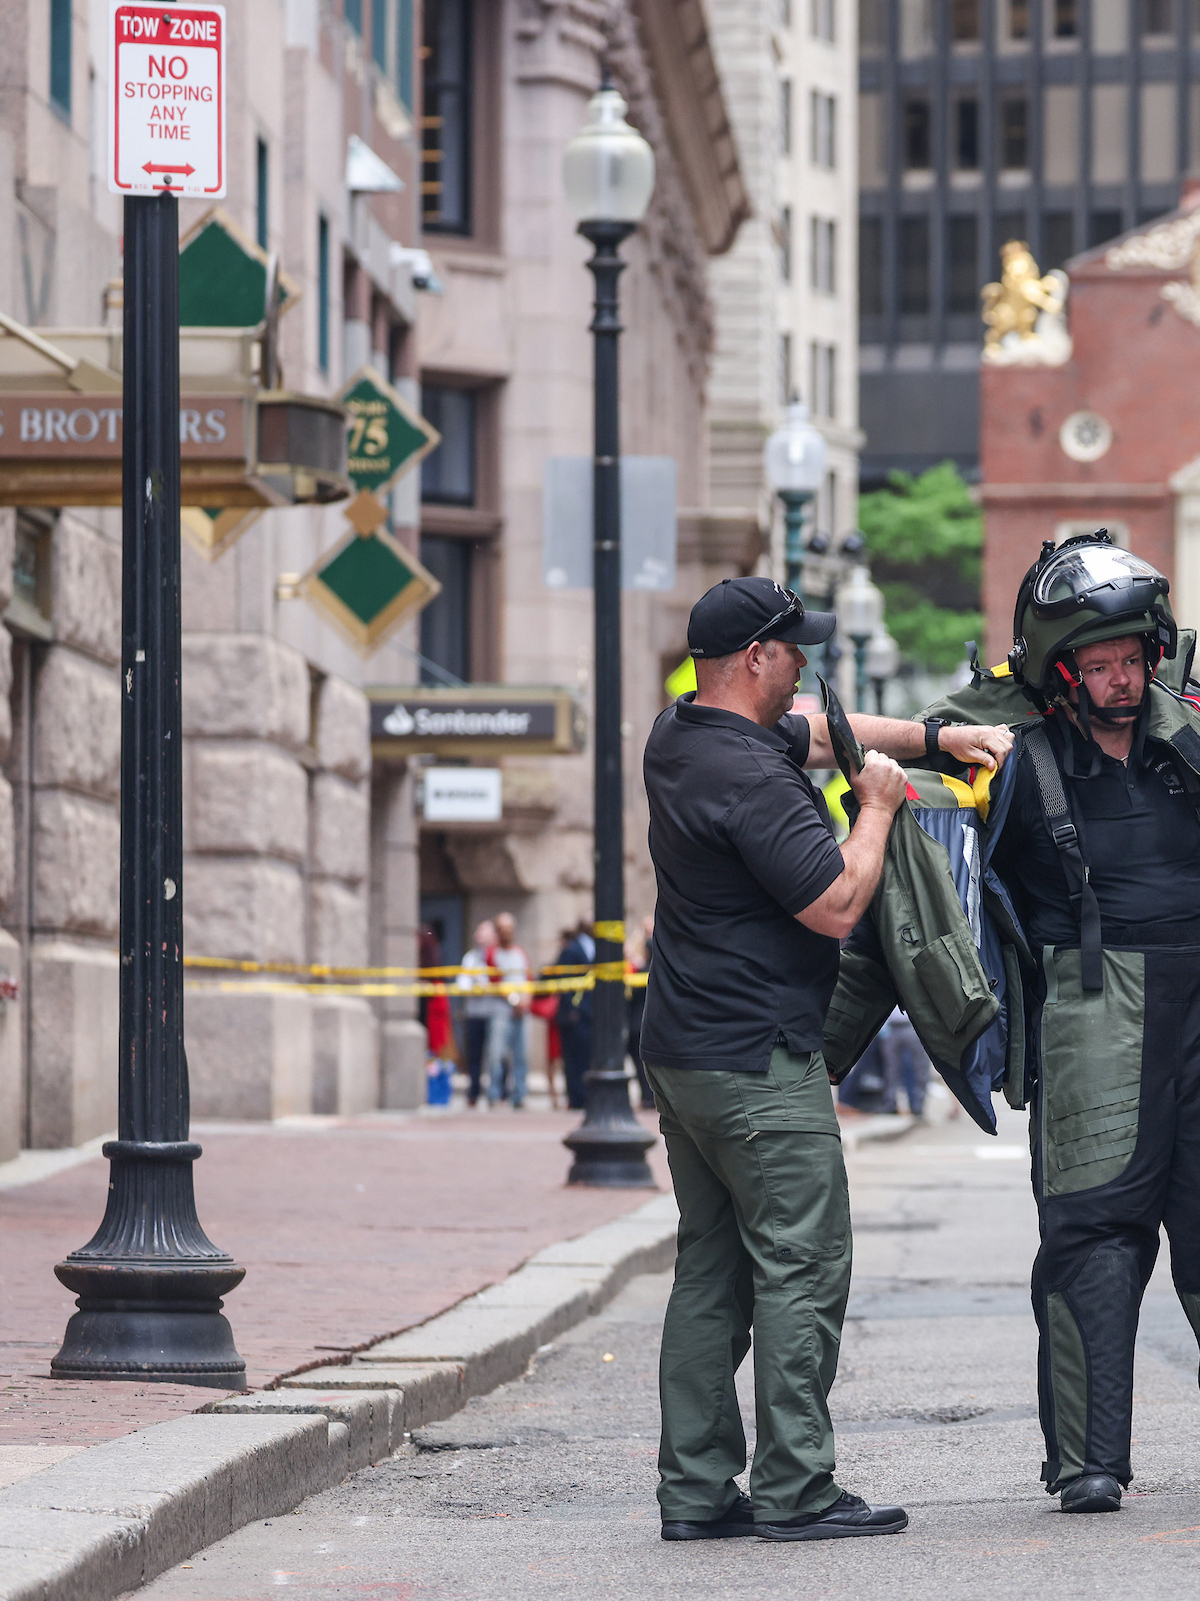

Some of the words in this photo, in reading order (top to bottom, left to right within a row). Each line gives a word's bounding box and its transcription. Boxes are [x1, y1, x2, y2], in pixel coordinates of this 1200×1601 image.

[120, 15, 160, 38] TOW
[169, 18, 217, 41] ZONE
[148, 54, 189, 79] NO
[125, 81, 213, 102] STOPPING
[150, 105, 187, 121] ANY
[147, 123, 191, 140] TIME
[20, 407, 227, 443] BROTRS
[348, 417, 388, 456] 75
[414, 707, 531, 735] Santander
